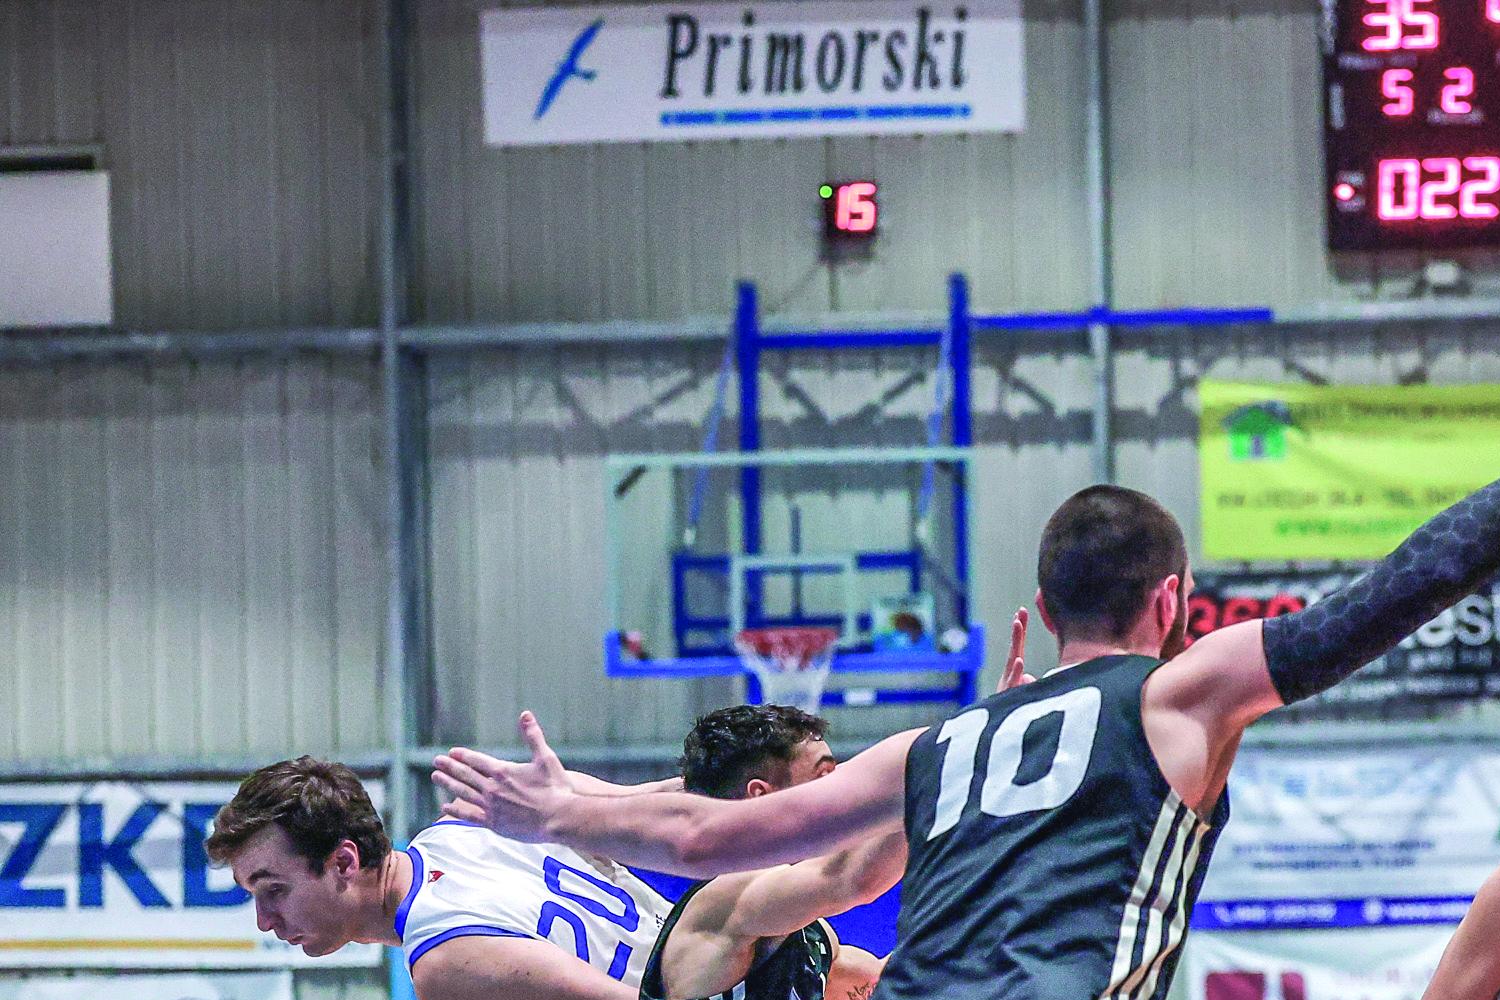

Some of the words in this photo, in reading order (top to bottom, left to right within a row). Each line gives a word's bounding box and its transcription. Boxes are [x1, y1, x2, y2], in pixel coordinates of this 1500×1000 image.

[660, 6, 970, 99] Primorski
[1361, 0, 1440, 51] 35
[1382, 69, 1414, 116] 5
[1441, 67, 1474, 114] 2
[926, 686, 1102, 842] 10
